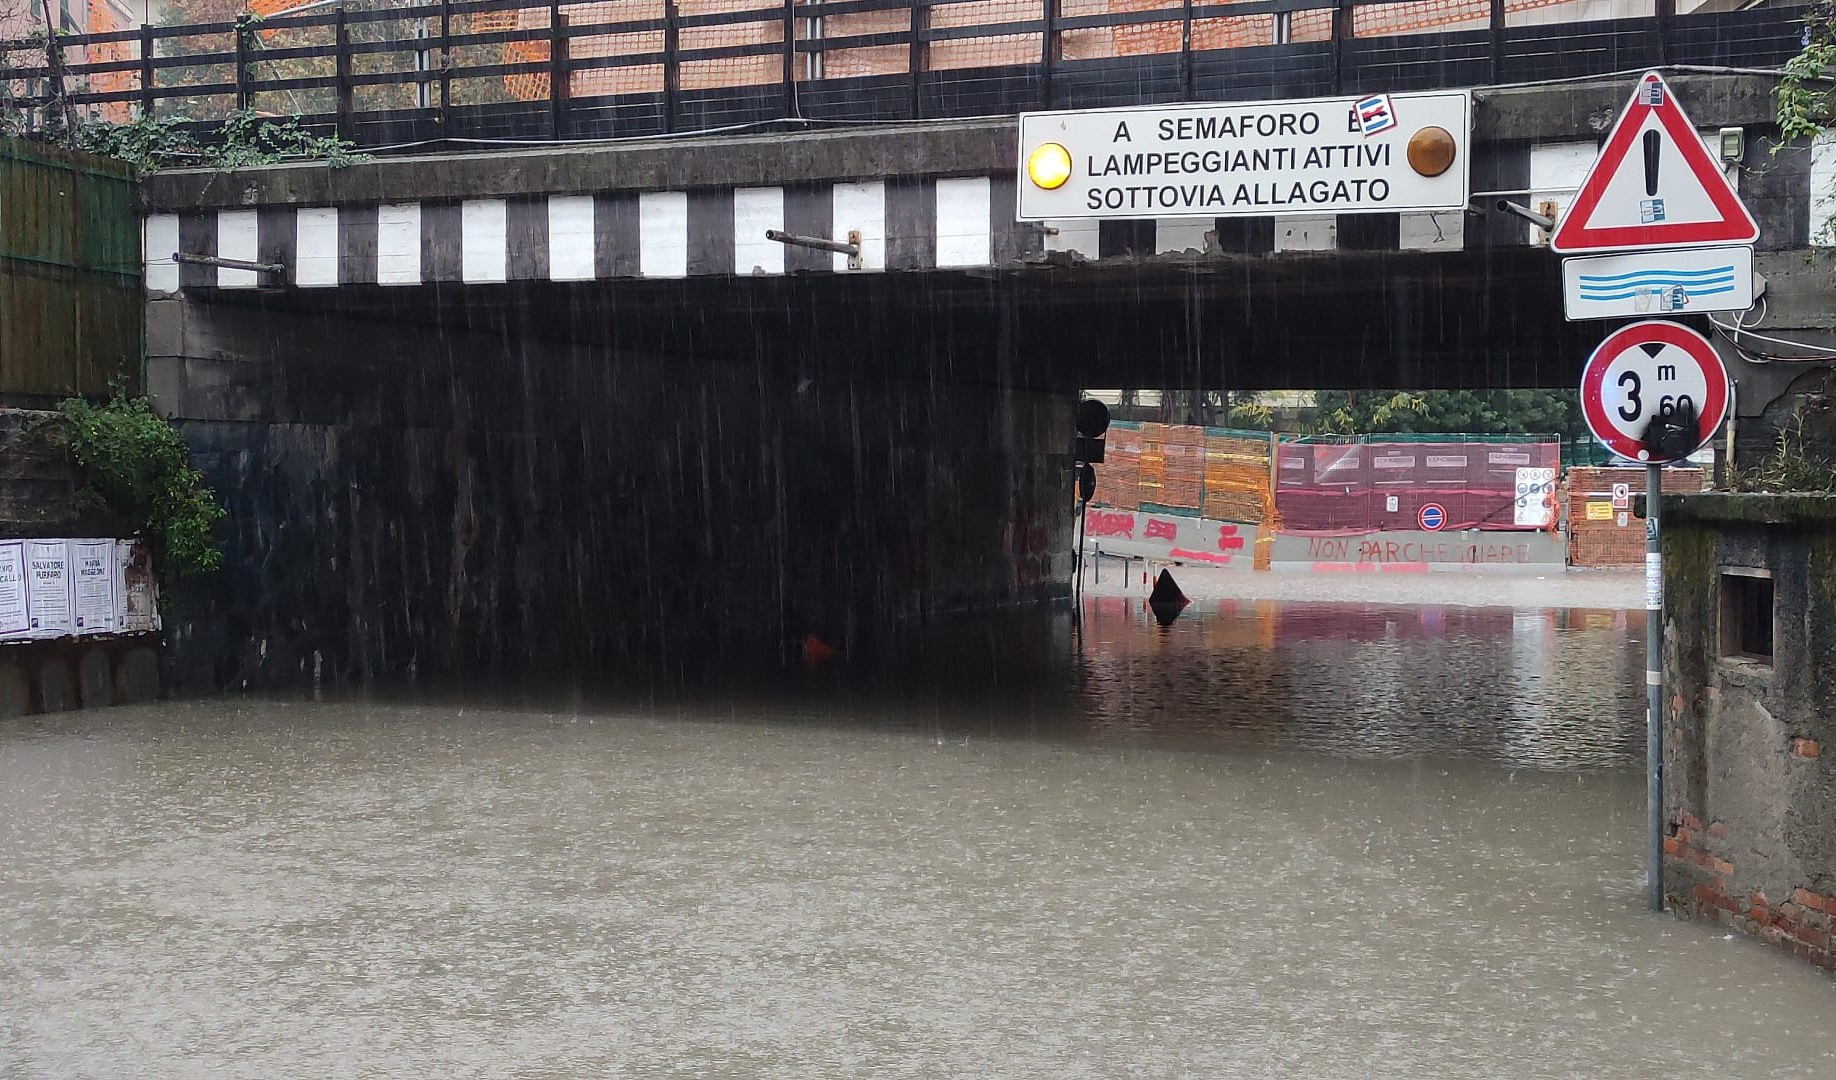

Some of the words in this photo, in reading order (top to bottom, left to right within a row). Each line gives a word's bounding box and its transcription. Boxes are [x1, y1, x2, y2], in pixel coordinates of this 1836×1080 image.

[1112, 120, 1133, 143] A
[1158, 112, 1320, 142] SEMAFORO
[1088, 147, 1296, 177] LAMPEGGIANTI
[1303, 143, 1390, 170] ATTIVI
[1087, 184, 1227, 210] SOTTOVIA
[1232, 179, 1390, 206] ALLAGATO
[1657, 364, 1676, 381] m
[1617, 370, 1642, 422] 3
[1659, 394, 1694, 417] 60
[1308, 538, 1349, 559] NON
